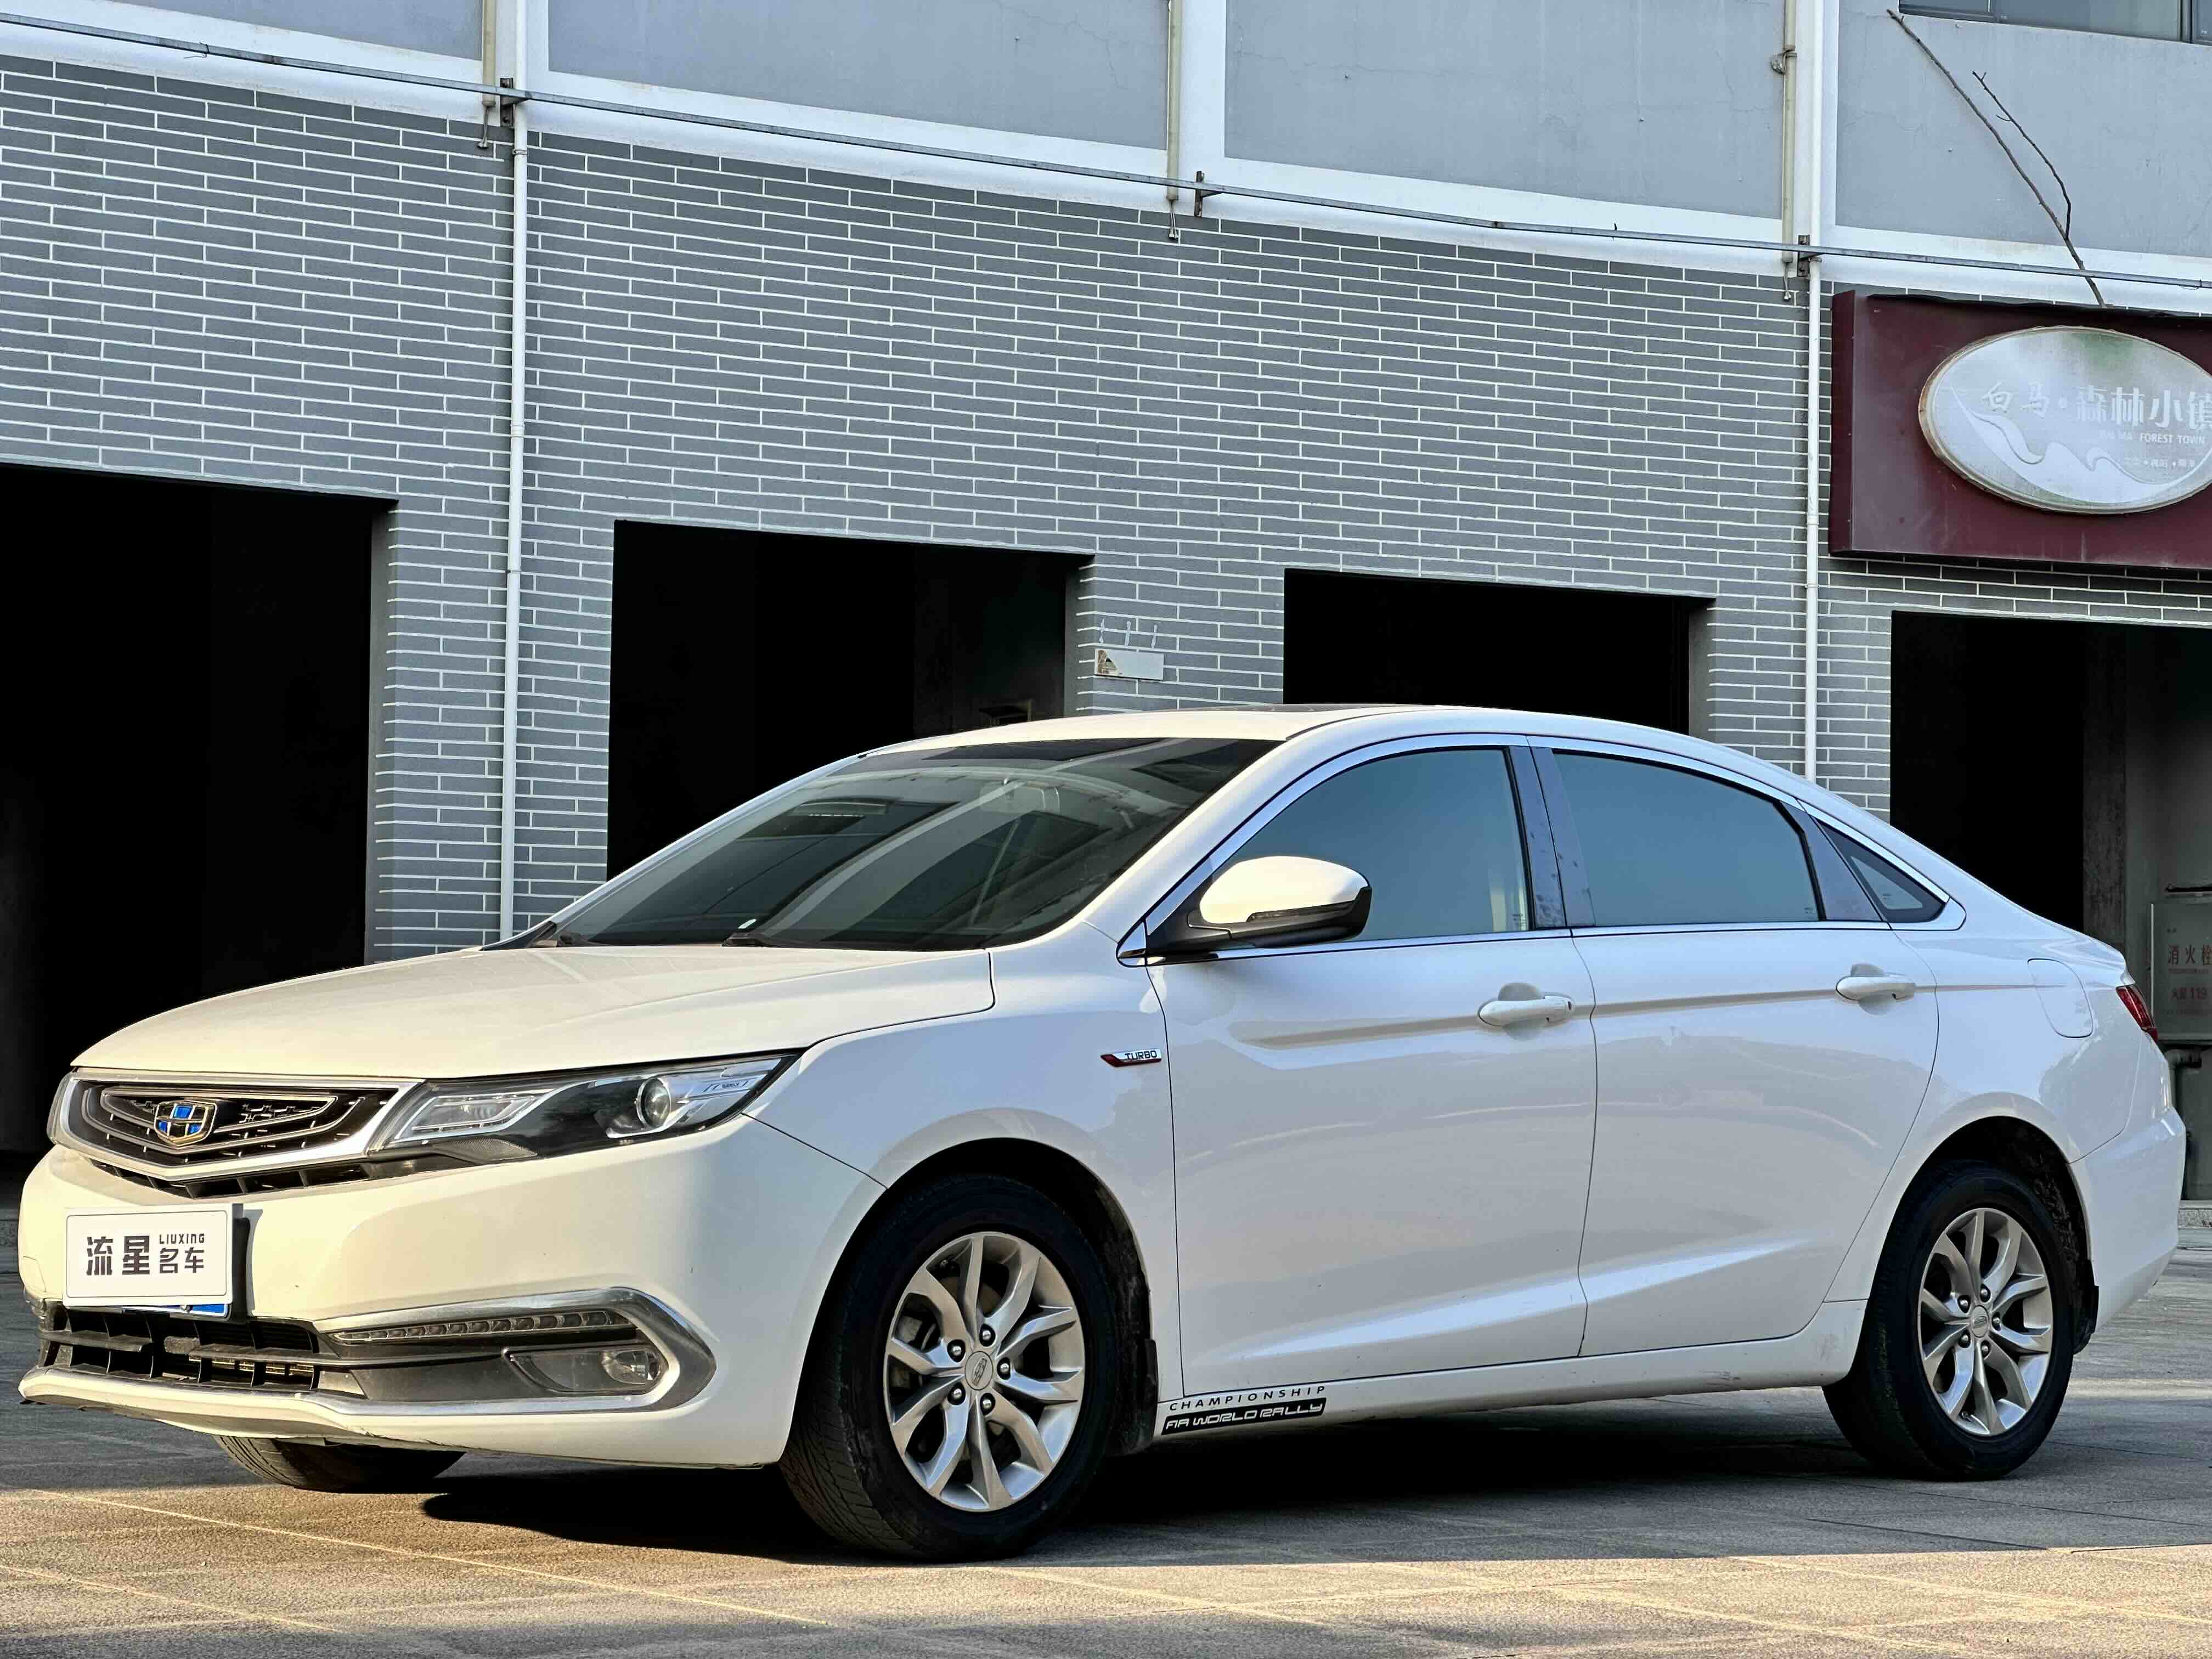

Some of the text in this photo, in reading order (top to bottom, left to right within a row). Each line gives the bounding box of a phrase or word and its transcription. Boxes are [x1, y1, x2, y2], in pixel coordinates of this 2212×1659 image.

[2140, 433, 2173, 444] FOREST
[2176, 435, 2205, 445] TOWN
[1125, 1050, 1157, 1060] TURBO
[159, 1233, 205, 1244] LIUXING
[86, 1235, 150, 1276] 流星
[159, 1247, 205, 1273] 名车
[1169, 1386, 1325, 1411] CHAMPIONSHIP
[1193, 1410, 1257, 1426] WORLD
[1259, 1403, 1323, 1418] RALLY
